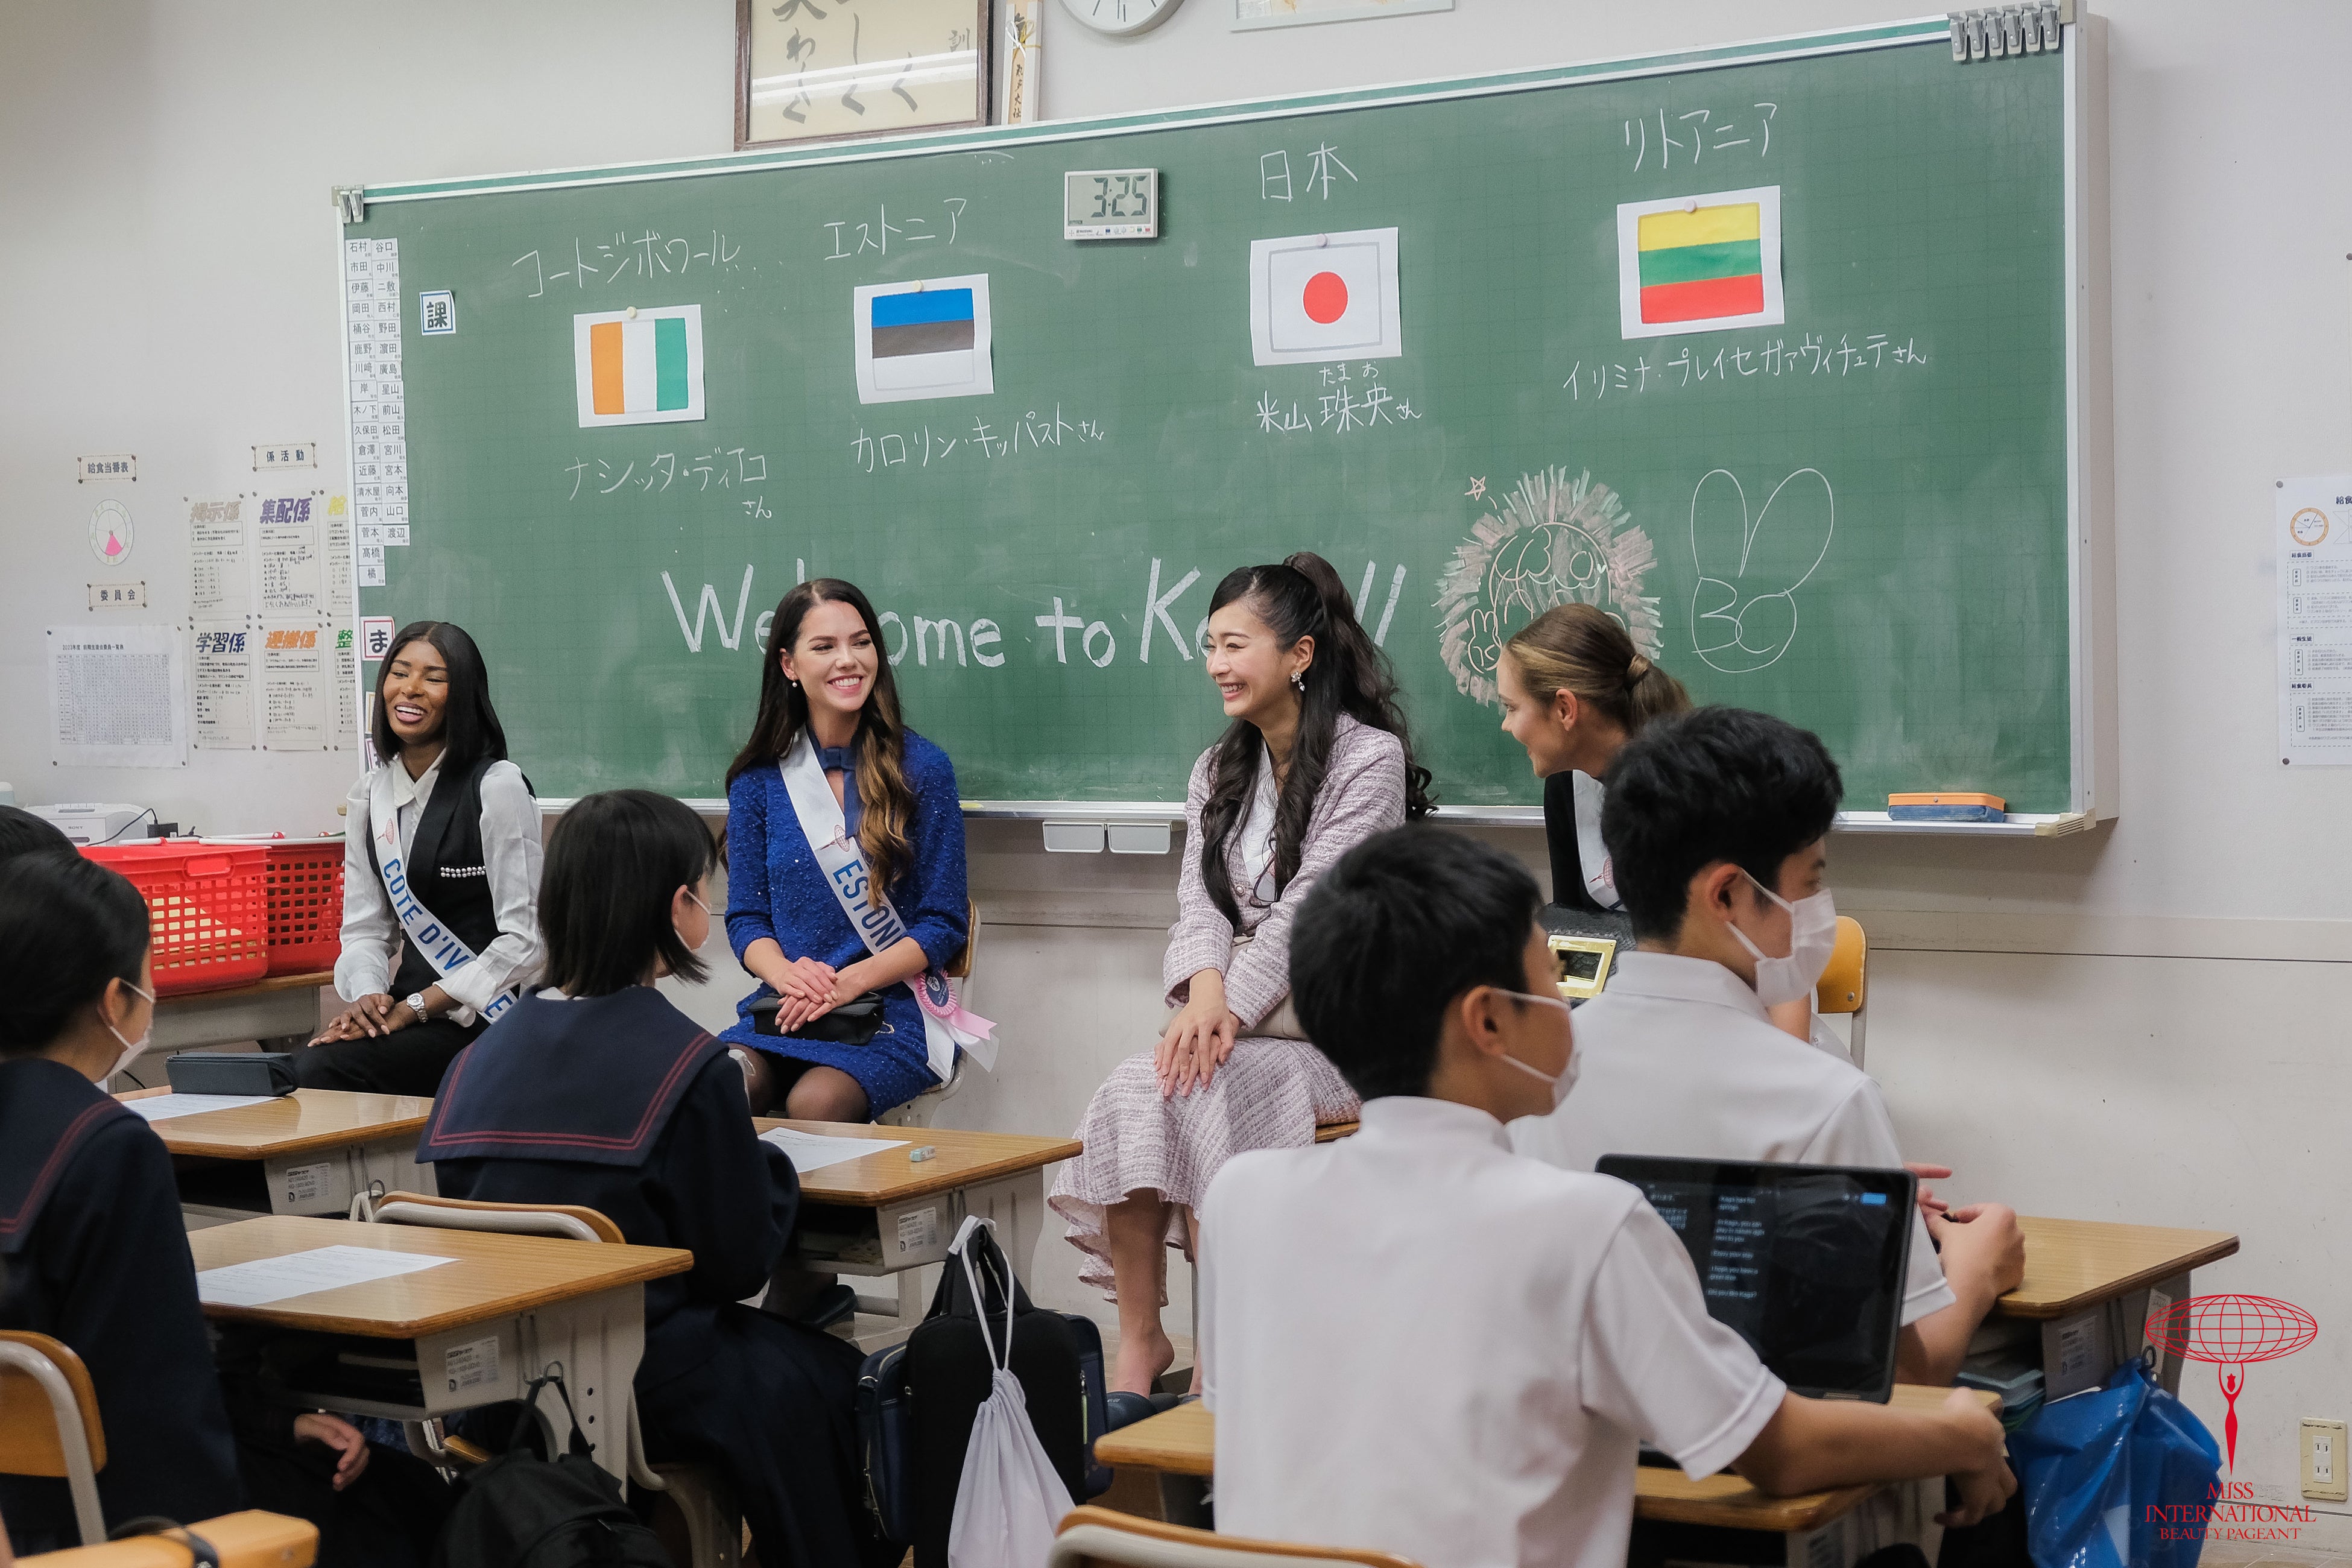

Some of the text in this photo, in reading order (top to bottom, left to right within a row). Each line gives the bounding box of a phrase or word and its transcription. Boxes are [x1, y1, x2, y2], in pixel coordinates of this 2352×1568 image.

[1625, 103, 1777, 172] リトアニア
[1260, 141, 1358, 202] 日本
[1091, 175, 1148, 218] 3:25
[824, 198, 967, 260] エストニア
[350, 241, 393, 253] 石村 谷口
[350, 262, 394, 273] 市田 中川
[512, 230, 741, 297] コートジボワール
[352, 282, 368, 294] 伊藤
[352, 302, 396, 314] 岡田 西村
[426, 301, 447, 329] 課
[379, 323, 396, 334] 野田
[354, 343, 372, 355] 鹿野
[353, 404, 400, 415] 木ノ下 前山
[355, 425, 400, 435] 久保田 松田
[266, 449, 305, 463] 係活動
[384, 444, 401, 455] 宮川
[87, 462, 128, 474] 給食当番表
[359, 464, 403, 476] 近藤 宮本
[357, 485, 403, 497] 清水屋 向本
[189, 500, 242, 523] 掲示係
[259, 498, 313, 525] 集配係
[327, 495, 348, 516] 給
[387, 506, 403, 516] 山口
[742, 496, 772, 518] さん
[100, 589, 135, 601] 委員会
[660, 558, 1005, 668] Weome
[1035, 596, 1115, 668] to
[195, 632, 247, 654] 学習係
[833, 859, 903, 952] ESON
[384, 858, 513, 1018] COTE D'IVE
